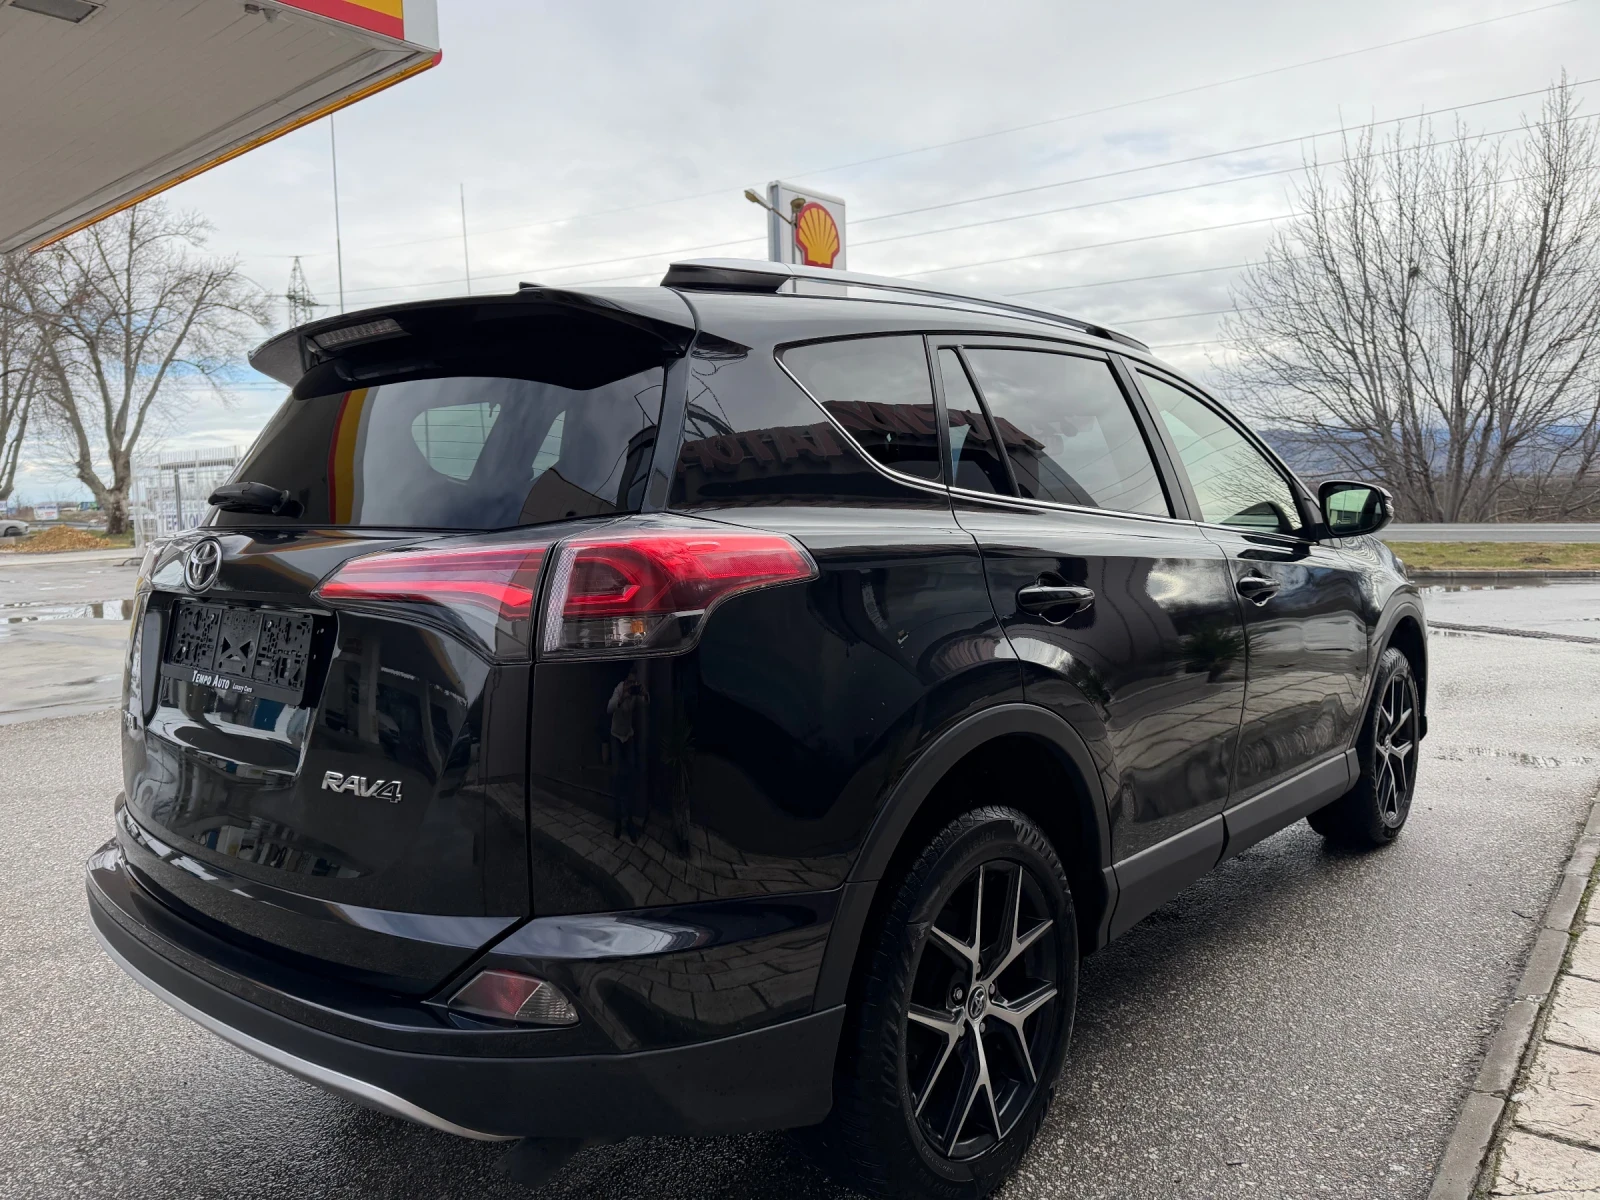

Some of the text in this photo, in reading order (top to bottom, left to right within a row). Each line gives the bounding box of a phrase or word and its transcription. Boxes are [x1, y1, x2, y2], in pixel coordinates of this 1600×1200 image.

[191, 670, 212, 685] TEMPO
[212, 674, 230, 689] AUTO
[321, 770, 403, 804] RAV4
